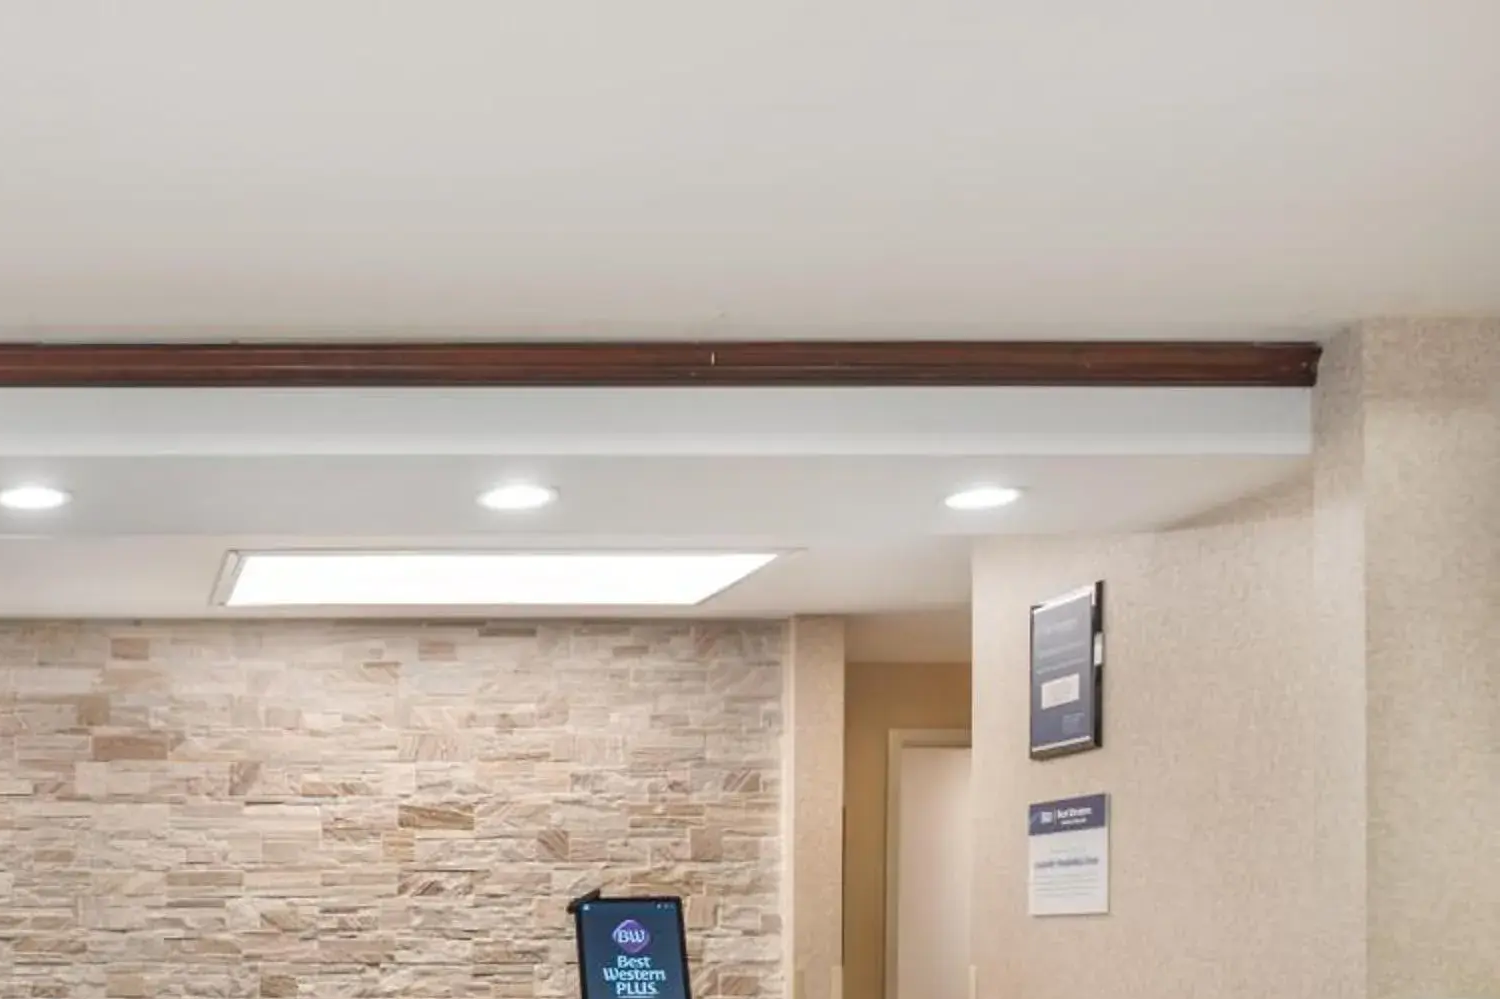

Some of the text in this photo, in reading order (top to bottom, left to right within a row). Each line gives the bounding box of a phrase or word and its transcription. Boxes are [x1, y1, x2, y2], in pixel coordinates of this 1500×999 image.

[618, 929, 645, 943] BW
[617, 955, 651, 969] Best
[603, 967, 666, 982] Western
[616, 981, 658, 995] PLUS
